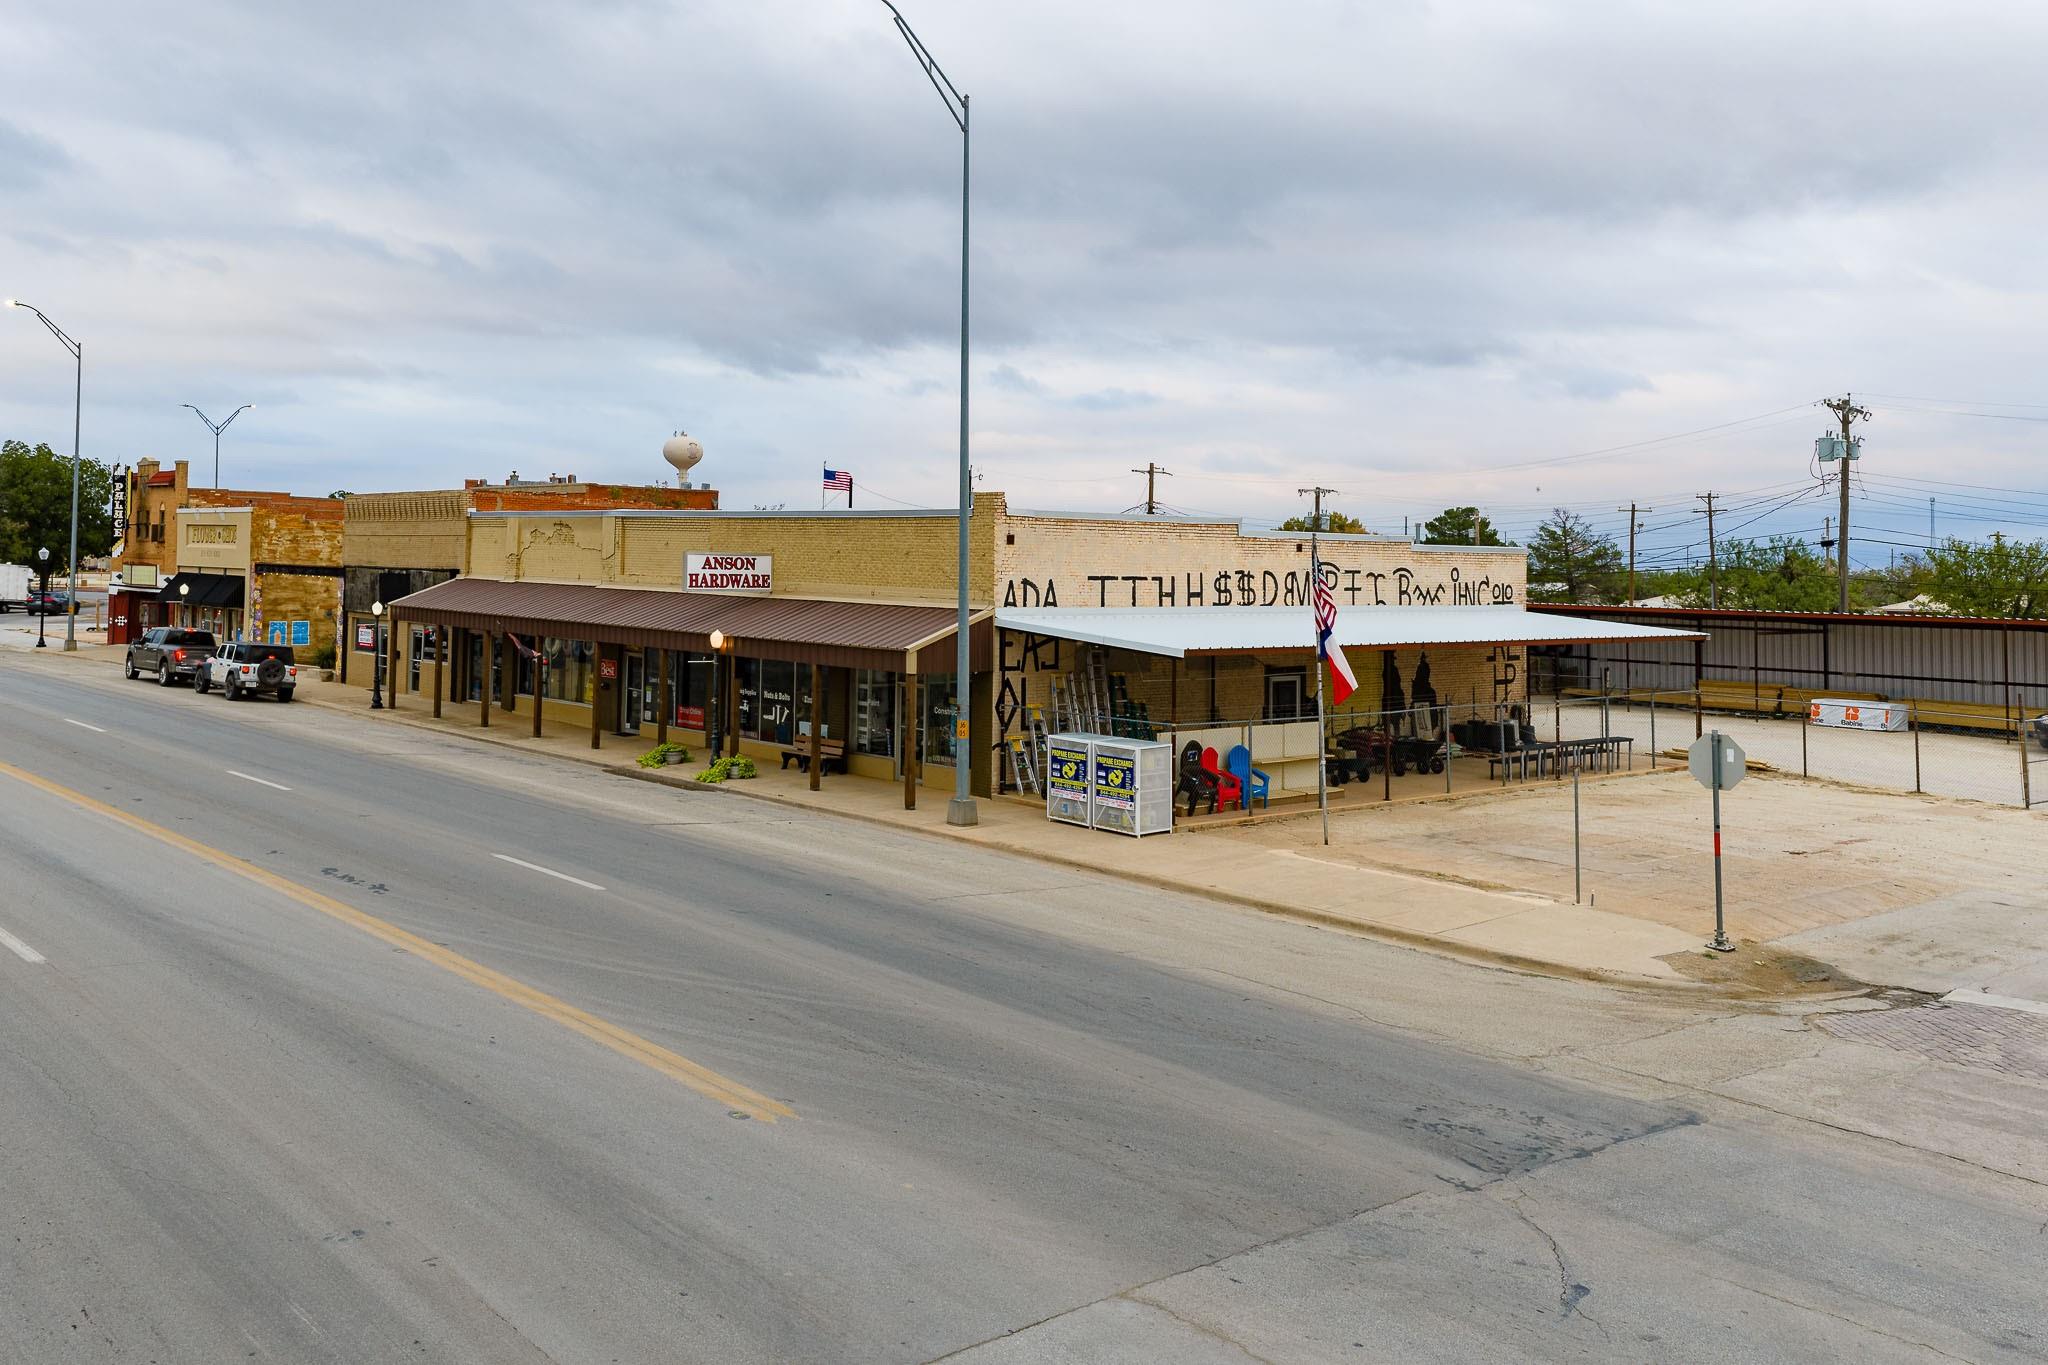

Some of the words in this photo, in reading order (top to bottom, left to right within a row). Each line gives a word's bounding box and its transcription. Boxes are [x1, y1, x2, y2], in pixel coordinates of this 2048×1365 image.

[113, 482, 124, 537] PALACE
[192, 526, 216, 543] FLOWER
[701, 556, 756, 570] ANSON
[688, 573, 770, 588] HARDWARE
[601, 662, 616, 676] Best
[763, 690, 774, 699] Nuts
[779, 692, 791, 701] Bolts
[1840, 719, 1863, 728] Babine
[1051, 749, 1068, 758] PROPANE
[1068, 752, 1086, 761] EXCHANGE
[1096, 756, 1114, 765] PROPANE
[1114, 759, 1134, 768] EXCHANGE
